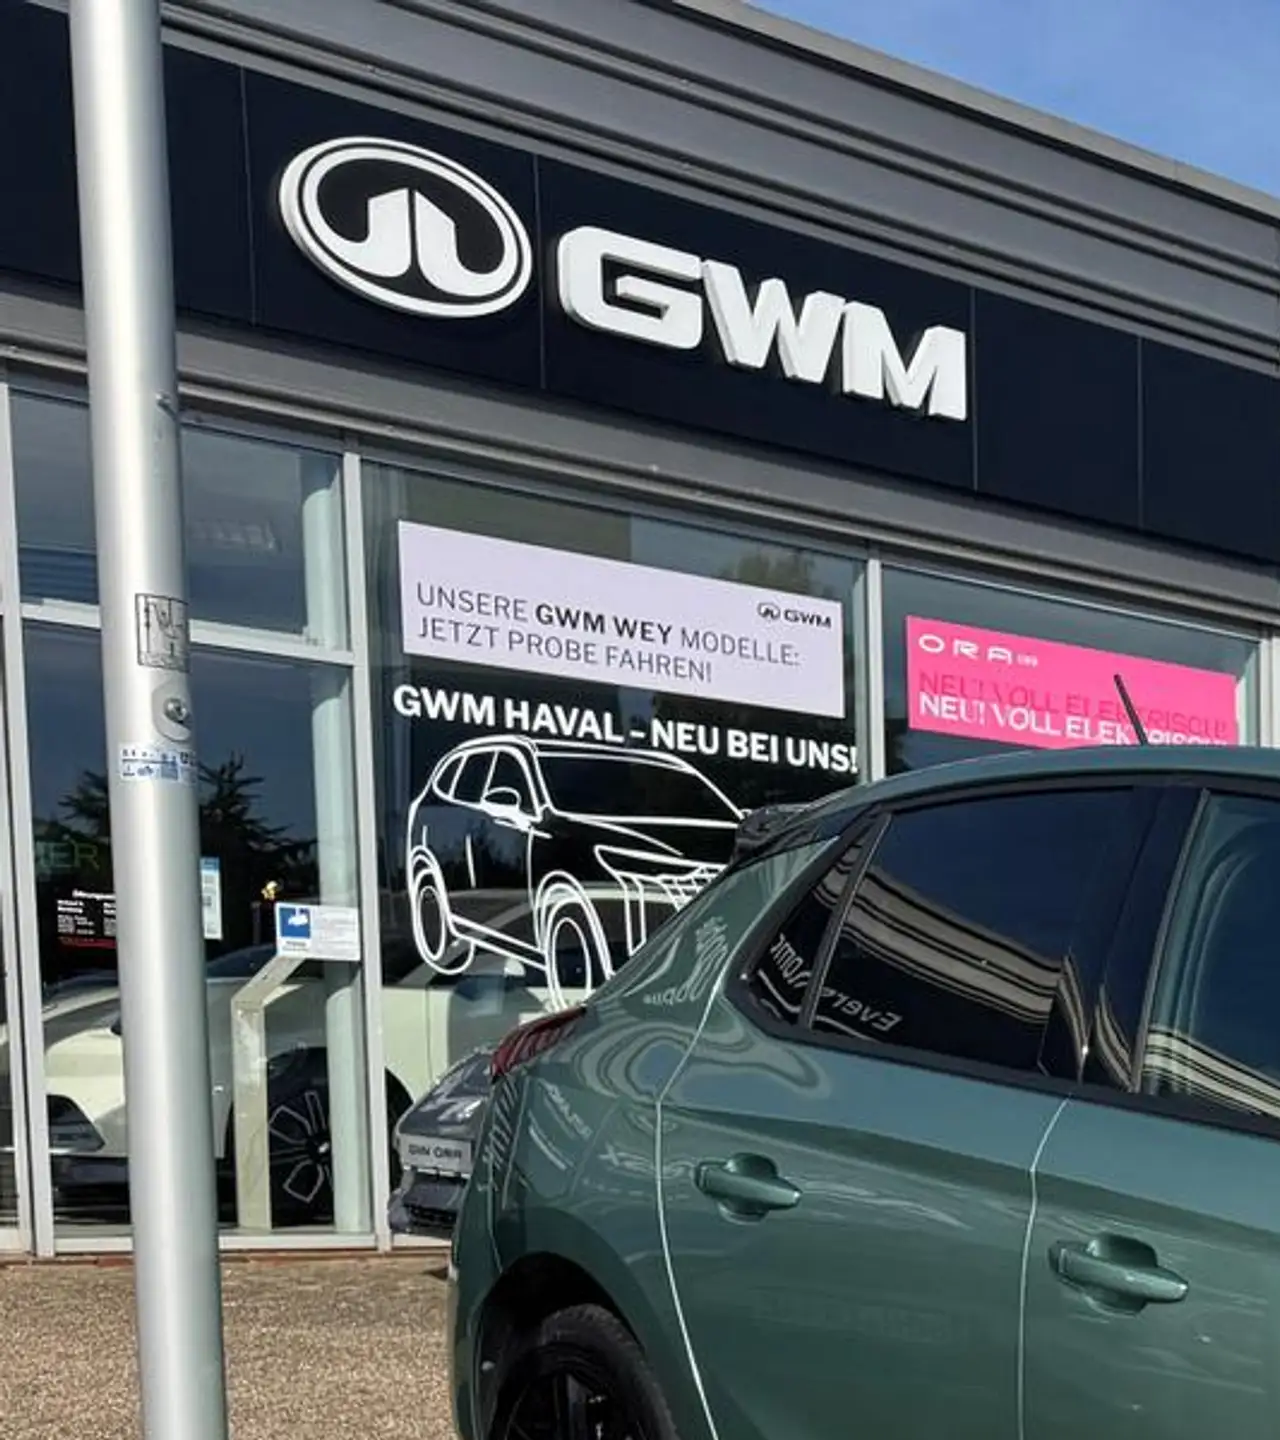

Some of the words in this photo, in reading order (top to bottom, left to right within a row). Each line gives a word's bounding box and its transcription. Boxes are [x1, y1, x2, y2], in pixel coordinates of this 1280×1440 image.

[557, 225, 969, 422] GWM
[416, 582, 529, 622] UNSERE
[535, 602, 605, 635] GWM
[613, 615, 673, 646] WEY
[680, 626, 801, 667] MODELLE:
[418, 617, 499, 649] JETZT
[508, 630, 599, 665] PROBE
[606, 645, 713, 684] FAHREN!
[783, 608, 833, 629] GWM
[918, 634, 1013, 666] ORA
[393, 684, 496, 727] GWM
[504, 698, 625, 743] HAVAL
[652, 718, 719, 756] NEU
[727, 729, 779, 764] BEI
[785, 736, 859, 774] UNS!
[992, 703, 1062, 737] VOLL
